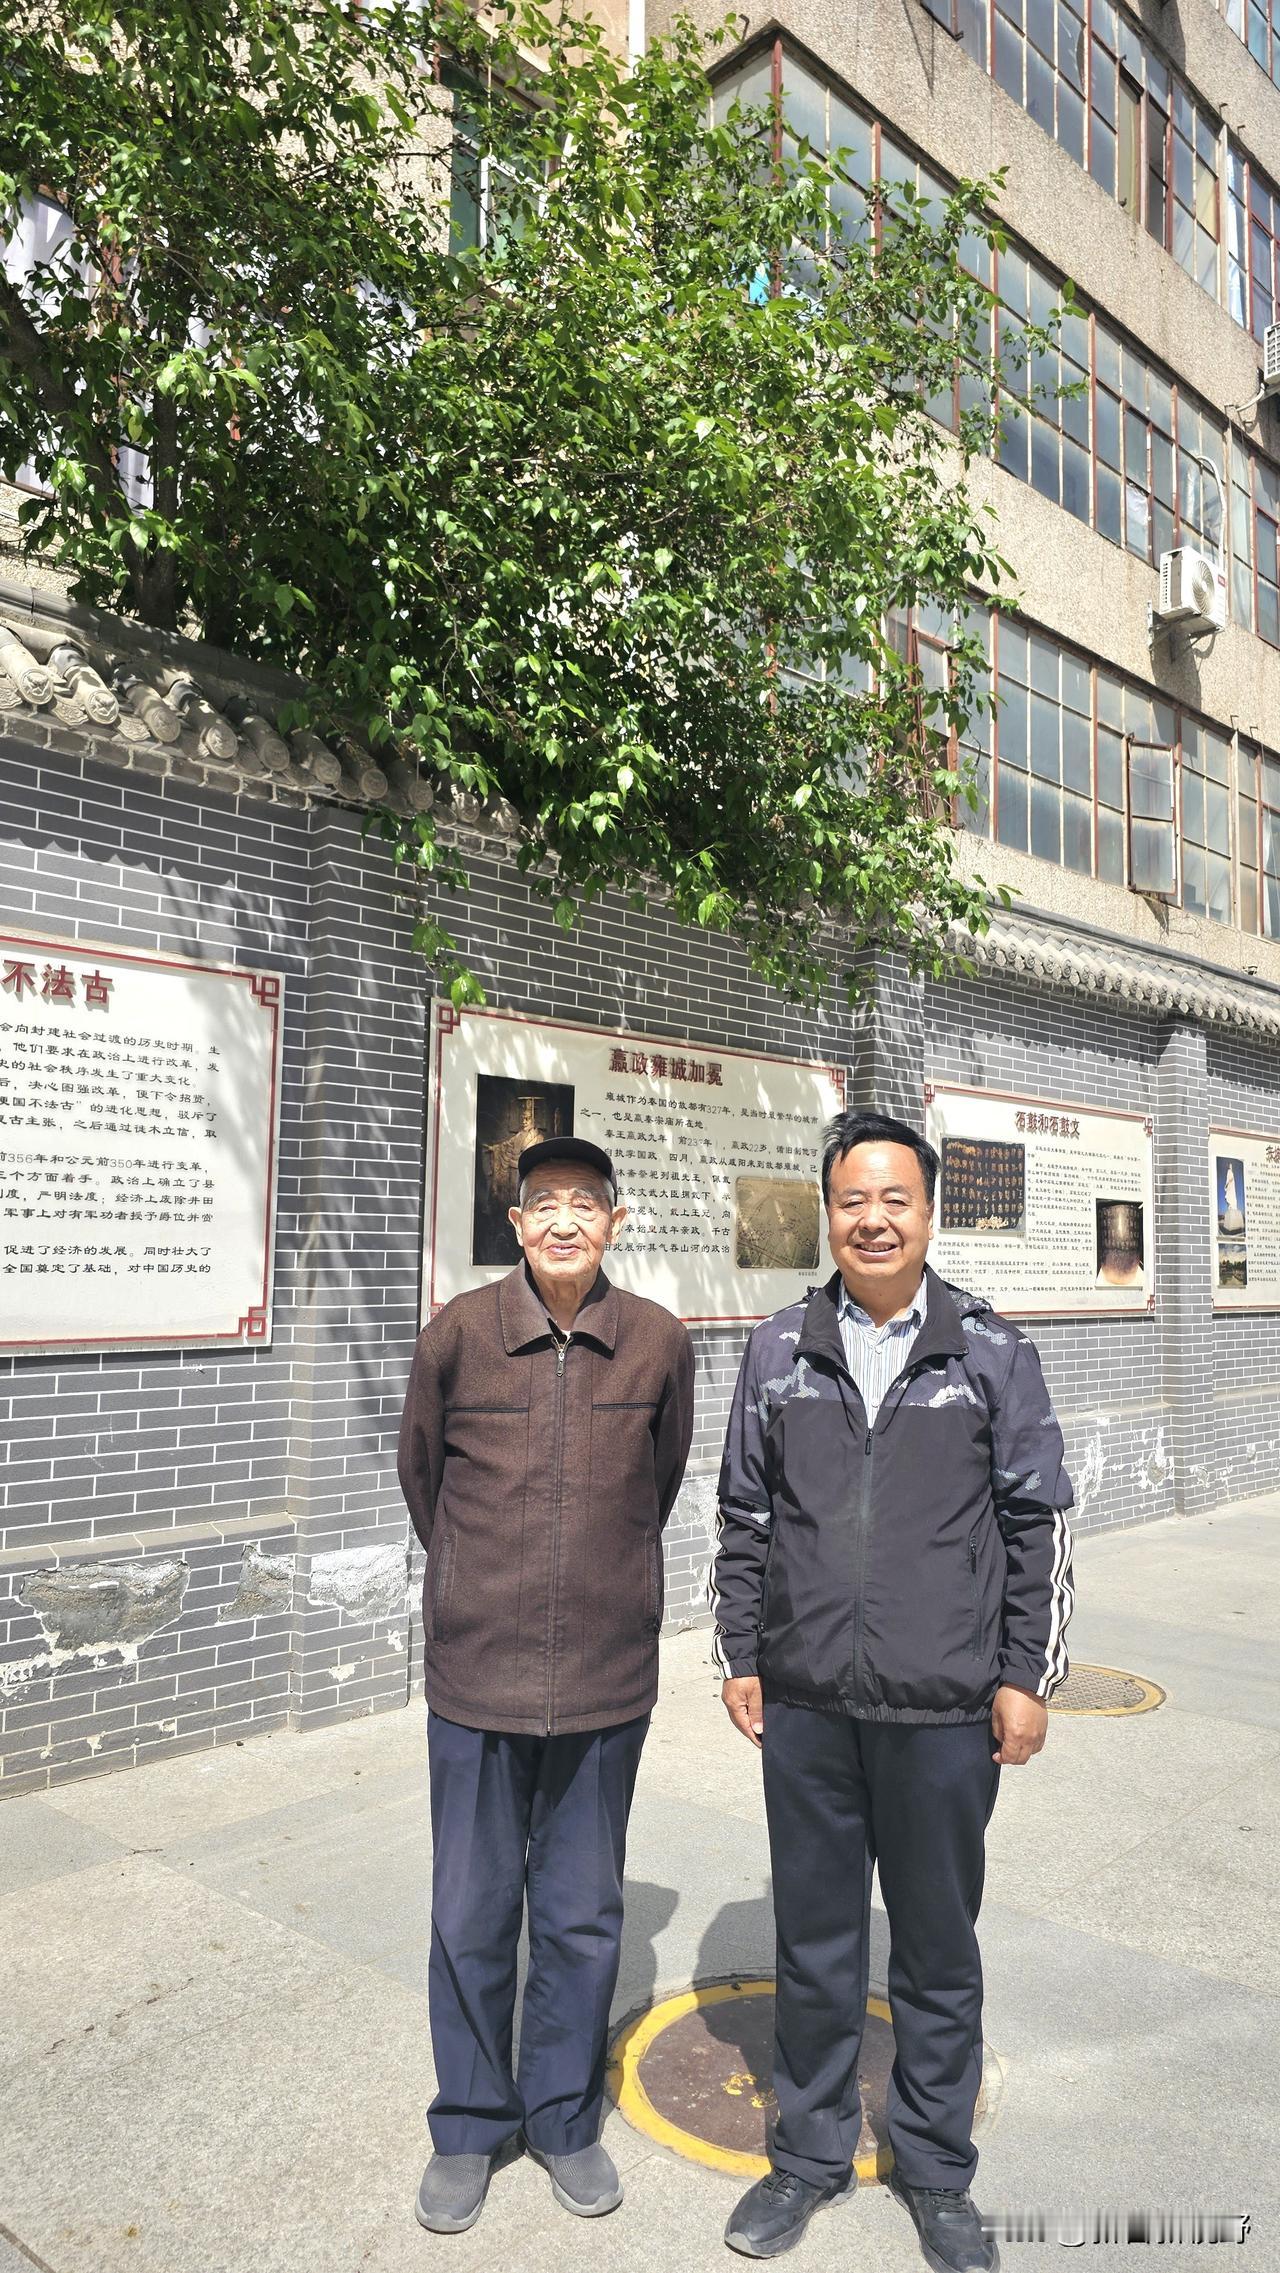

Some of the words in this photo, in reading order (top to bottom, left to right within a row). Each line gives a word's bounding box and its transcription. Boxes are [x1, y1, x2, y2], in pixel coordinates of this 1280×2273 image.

[1, 959, 114, 1005] 不法古
[1015, 1111, 1081, 1136] 石鼓和石鼓文
[0, 1188, 214, 1205] 度，严明法度；经济上废除井田
[3, 1207, 214, 1223] 军事上对有军功者授予爵位并赏
[619, 1223, 731, 1237] 秦始皇成年亲政。千古
[3, 1244, 212, 1258] 促进了经济的发展。同时壮大了
[3, 1262, 212, 1276] 全国奠定了基础，对中国历史的
